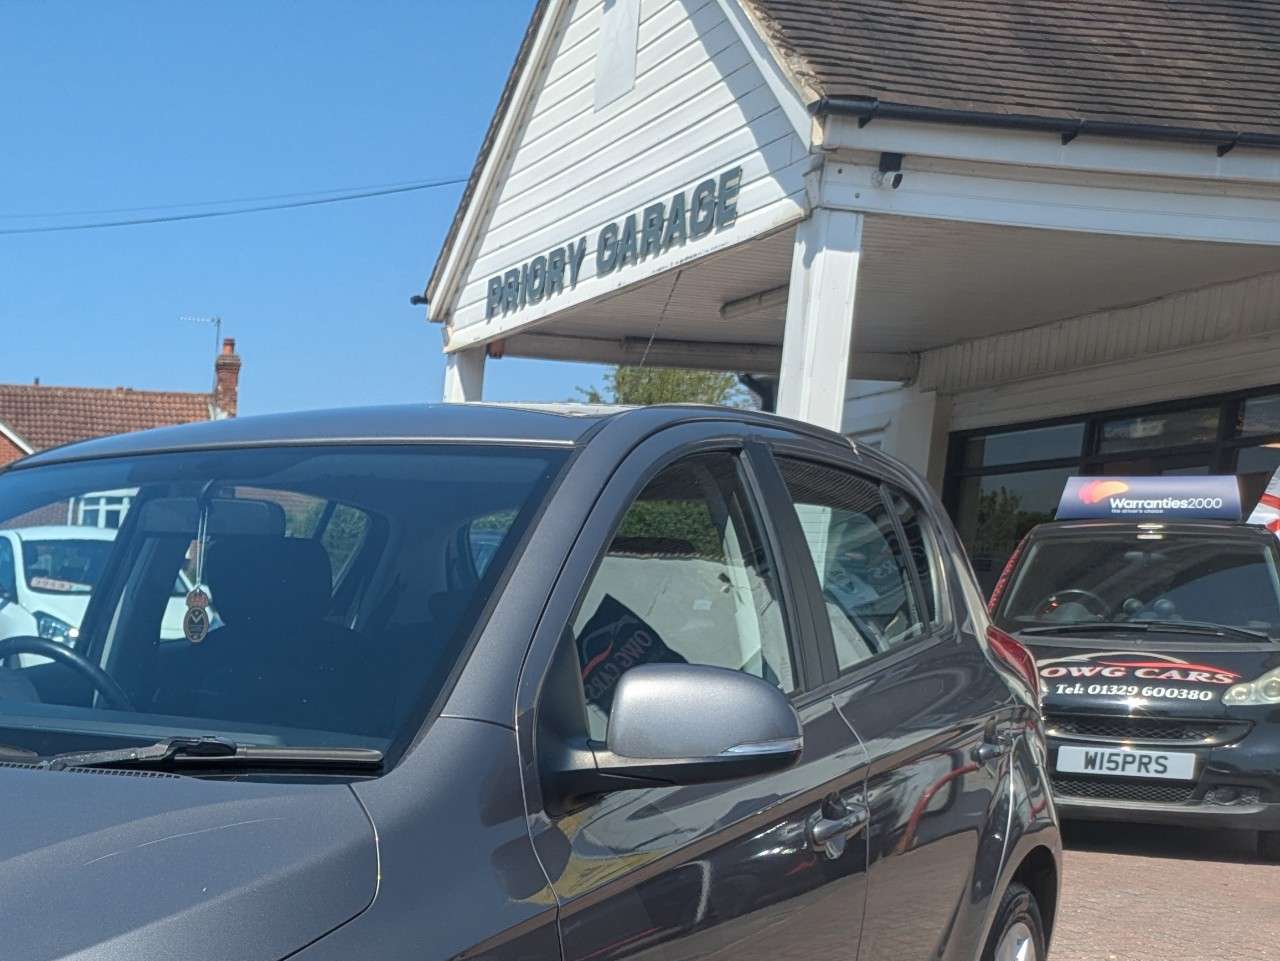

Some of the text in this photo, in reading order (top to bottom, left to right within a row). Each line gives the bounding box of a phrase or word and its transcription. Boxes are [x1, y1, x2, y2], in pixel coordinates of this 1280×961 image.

[486, 165, 743, 324] PRIORY GARAGE
[1039, 666, 1235, 684] OWG CARS
[1055, 683, 1213, 701] Tel: 01329 600380
